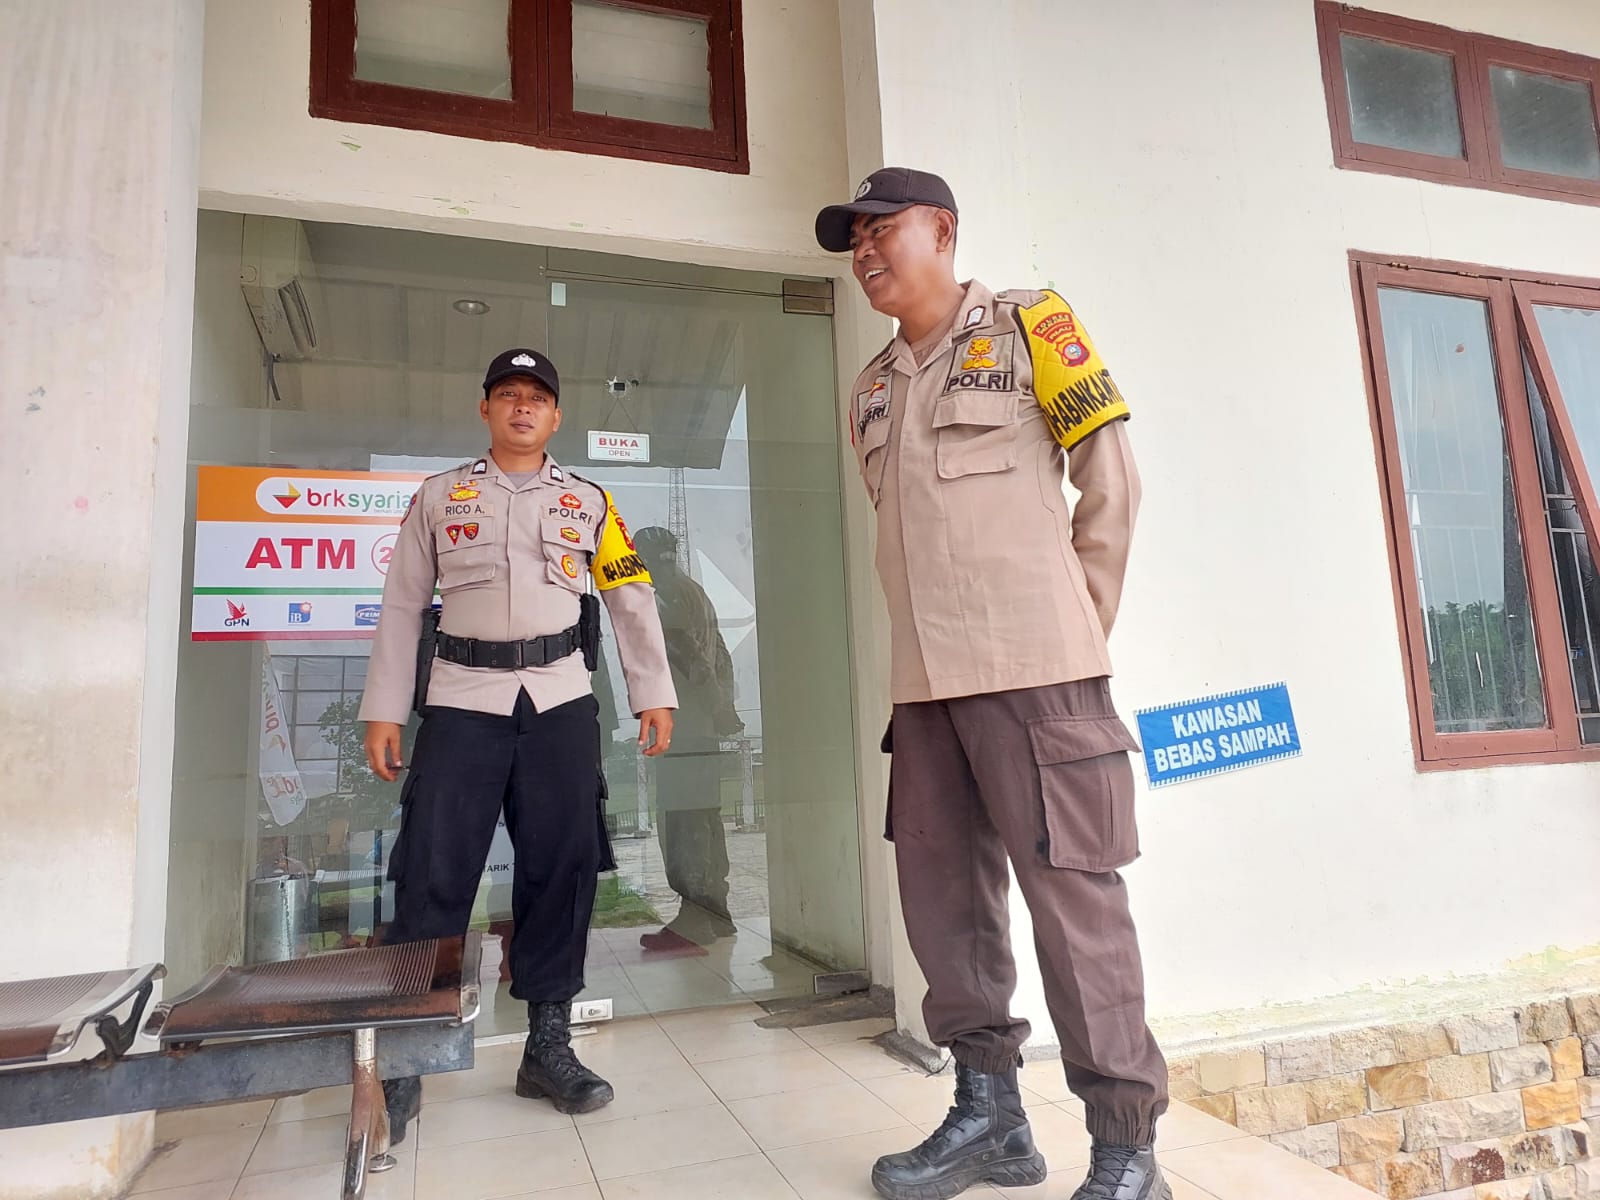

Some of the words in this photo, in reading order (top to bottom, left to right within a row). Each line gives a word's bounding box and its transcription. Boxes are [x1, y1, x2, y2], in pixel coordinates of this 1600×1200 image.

[947, 372, 1008, 391] POLRI
[598, 437, 639, 448] BUKA
[608, 449, 631, 457] OPEN
[445, 504, 471, 516] RICO
[474, 504, 485, 515] A.
[548, 507, 593, 525] POLRI
[245, 537, 356, 570] ATM
[224, 617, 250, 627] GPN
[290, 612, 303, 623] iB
[1171, 698, 1263, 739] KAWASAN
[1153, 737, 1217, 773] BEBAS
[1218, 721, 1292, 759] SAMPAH
